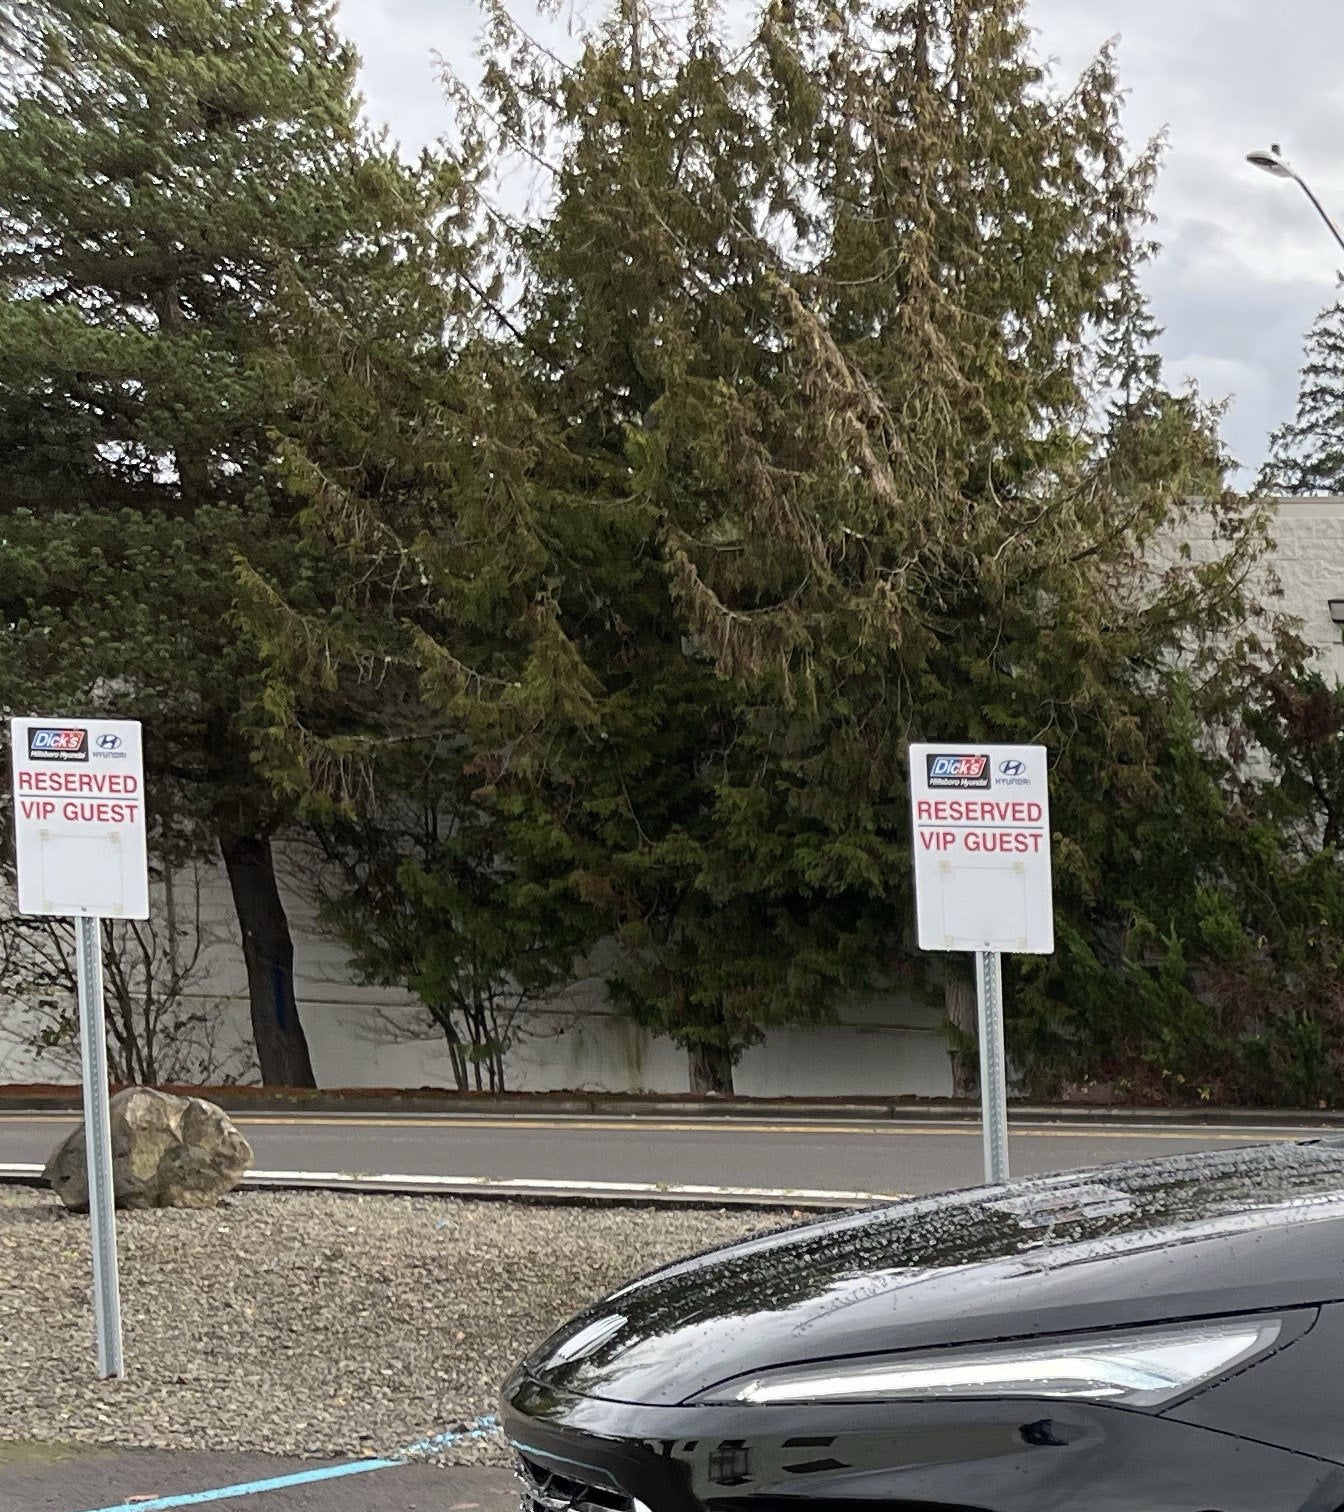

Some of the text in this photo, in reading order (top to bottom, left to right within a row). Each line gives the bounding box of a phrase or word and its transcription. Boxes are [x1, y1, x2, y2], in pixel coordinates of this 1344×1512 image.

[934, 759, 980, 775] Dick's
[18, 771, 138, 794] RESERVED
[20, 800, 139, 824] VIP GUEST
[917, 800, 1043, 822] RESERVED
[919, 830, 1043, 853] VIP GUEST
